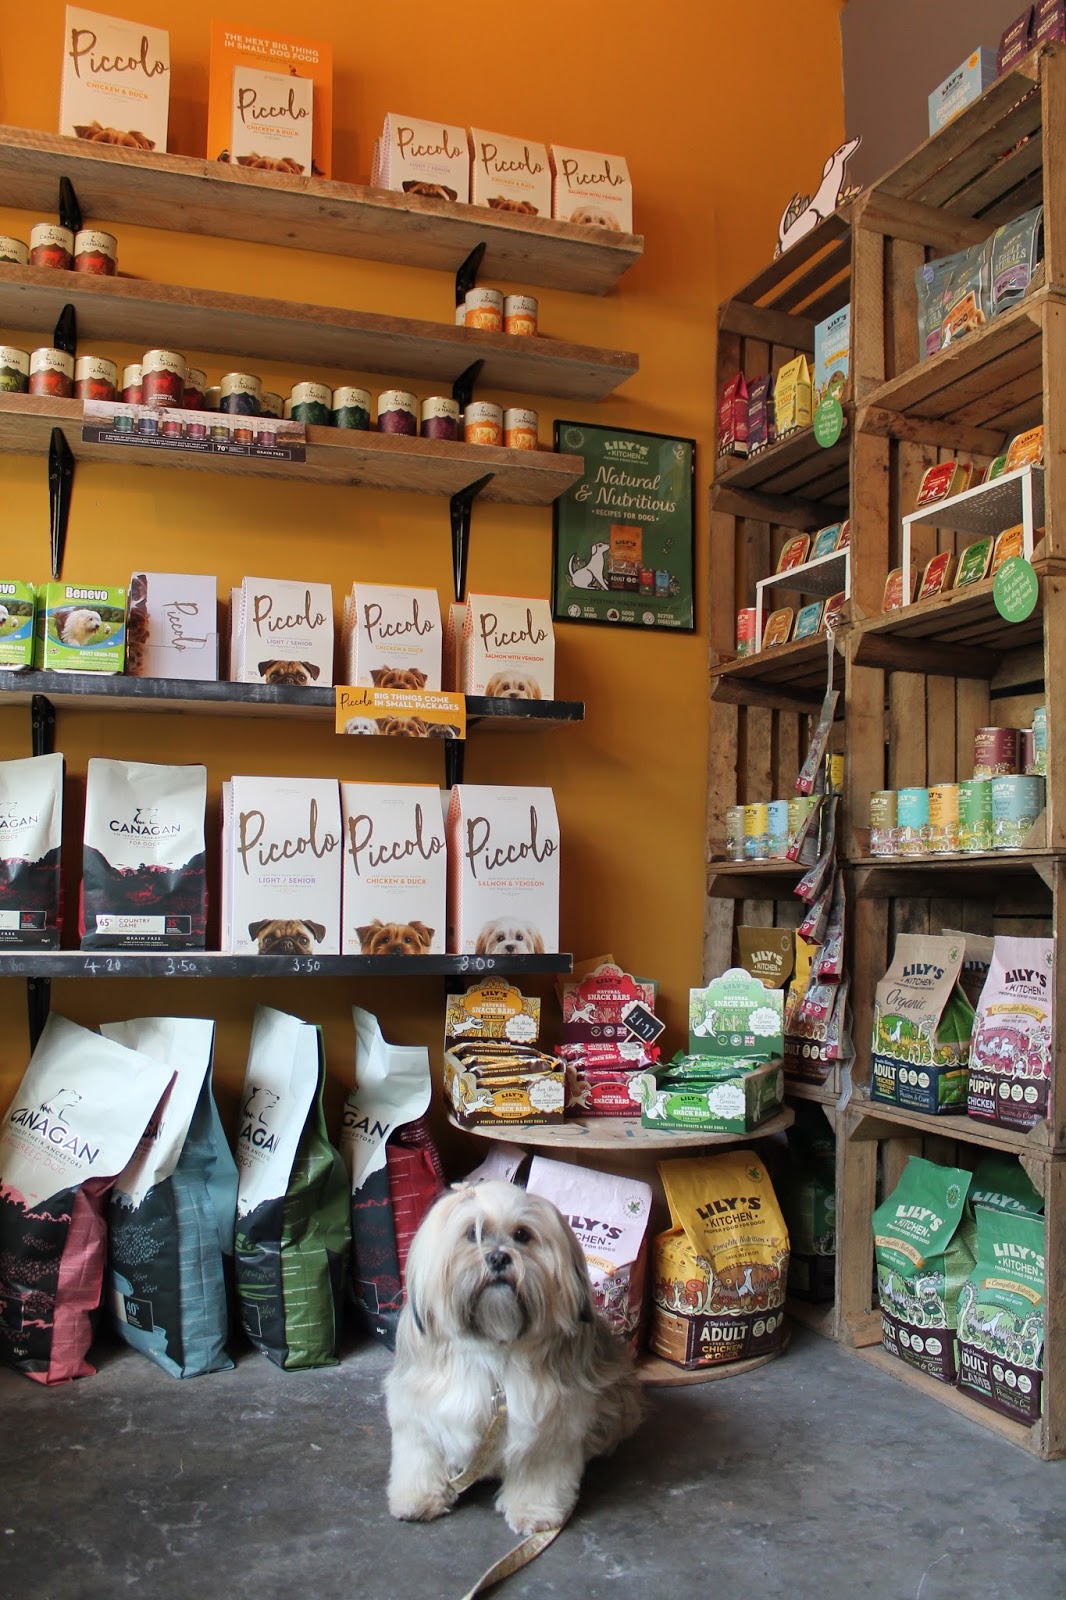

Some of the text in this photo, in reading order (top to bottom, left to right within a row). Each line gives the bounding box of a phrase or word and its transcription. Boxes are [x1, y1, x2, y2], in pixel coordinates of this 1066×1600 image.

[70, 29, 168, 78] Piccolo
[224, 40, 235, 48] IN
[237, 42, 268, 54] SMALL
[270, 48, 291, 58] DOG
[292, 52, 319, 63] FOOD
[225, 33, 319, 57] THE NEXT BIG THING
[86, 81, 120, 94] CHICKEN
[129, 90, 149, 99] DUCK
[237, 88, 309, 124] Piccolo
[247, 124, 275, 133] CHICKEN
[397, 127, 463, 160] Piccolo
[481, 143, 544, 175] Piccolo
[562, 159, 625, 187] Piccolo
[568, 189, 588, 197] SALMON
[604, 441, 649, 455] LILY'S
[611, 450, 640, 459] KITCHEN
[595, 466, 661, 490] Natural
[575, 485, 592, 501] &
[595, 487, 676, 512] Nutritious
[596, 509, 621, 517] RECIPES
[65, 586, 108, 600] Benevo
[253, 590, 327, 638] Piccolo
[364, 598, 435, 644] Piccolo
[162, 601, 207, 652] Piccolo
[480, 608, 549, 652] Piccolo
[266, 638, 313, 647] LIGHT SENIOR
[375, 644, 401, 652] CHICKEN
[340, 690, 372, 710] Piccolo
[386, 700, 413, 708] SMALL
[416, 702, 459, 710] PACKAGES
[109, 820, 181, 835] CANAGAN
[238, 798, 340, 876] Piccolo
[348, 803, 445, 876] Piccolo
[465, 805, 558, 879] Piccolo
[84, 958, 121, 973] 4.20
[165, 958, 196, 975] 3.50
[293, 959, 321, 971] 3.50
[751, 951, 783, 966] LILY'S
[757, 963, 778, 971] KITCHEN
[903, 964, 945, 979] LILY'S
[1005, 969, 1047, 988] LILY'S
[481, 990, 508, 998] LILY'S
[1009, 984, 1041, 995] KITCHEN
[886, 989, 926, 1011] Organic
[874, 1063, 897, 1079] ADULT
[968, 1080, 996, 1096] PUPPY
[967, 1095, 996, 1109] CHICKEN
[11, 1108, 99, 1164] CANAGAN
[28, 1133, 82, 1168] THEIR ANCESTORS
[44, 1159, 66, 1175] DOG
[696, 1197, 761, 1220] LILY'S
[709, 1211, 753, 1228] KITCHEN
[896, 1205, 943, 1231] LILY'S
[897, 1218, 929, 1237] KITCHEN
[576, 1232, 606, 1245] CHEN
[713, 1235, 765, 1251] Complete Nutrition
[919, 1237, 930, 1245] DOGS
[993, 1243, 1045, 1269] LILY'S
[1003, 1257, 1039, 1276] KITCHEN
[992, 1279, 1035, 1299] Complete Nutrition
[700, 1326, 748, 1341] ADULT
[702, 1344, 743, 1352] CHICKEN
[961, 1368, 992, 1390] LAMB
